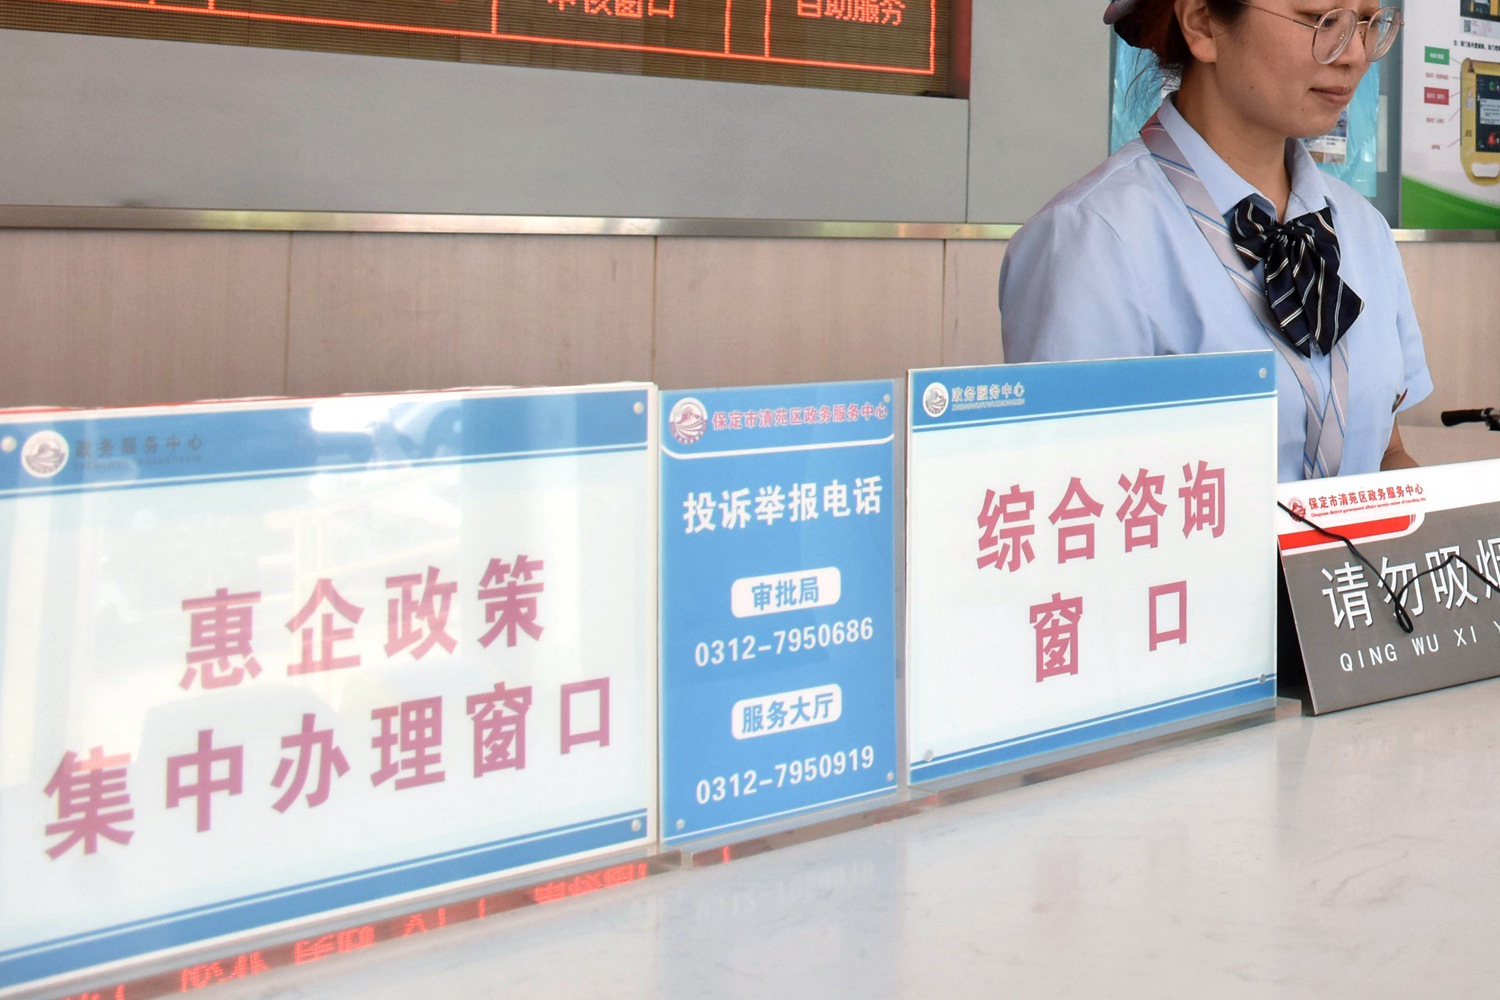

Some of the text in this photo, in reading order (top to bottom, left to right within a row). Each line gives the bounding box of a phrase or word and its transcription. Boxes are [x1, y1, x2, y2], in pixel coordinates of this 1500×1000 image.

[711, 402, 888, 431] 保定市清苑区政务服务中心
[682, 475, 882, 534] 投诉举报电话
[976, 459, 1227, 573] 综合咨询
[1308, 483, 1424, 510] 保定市清苑区政务服务中心
[751, 576, 819, 611] 审批局
[179, 554, 545, 691] 惠企政策
[695, 617, 873, 667] 0312-7950686
[1029, 579, 1187, 683] 窗口
[1339, 643, 1398, 672] QING
[1412, 634, 1439, 656] WU
[1454, 625, 1477, 647] XI
[741, 692, 834, 734] 服务大厅
[44, 677, 612, 861] 集中办理窗口
[696, 745, 874, 805] 0312-7950919
